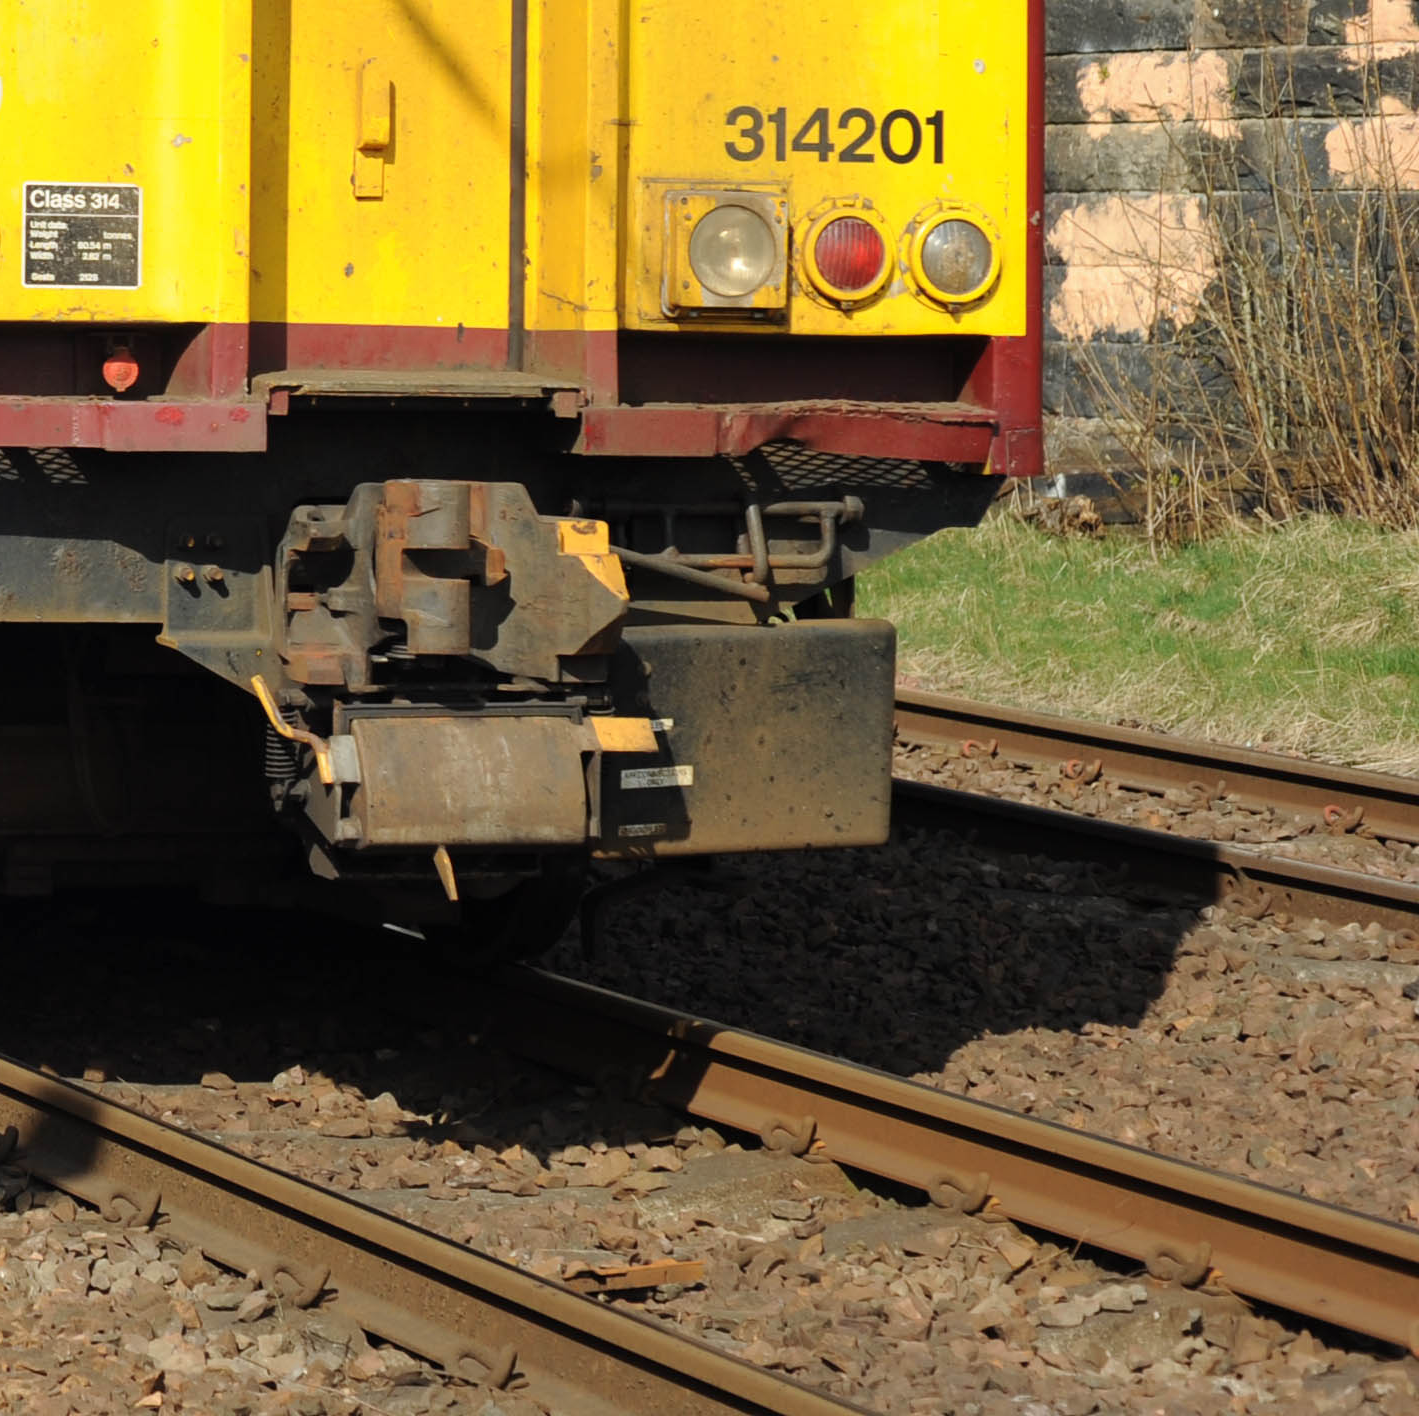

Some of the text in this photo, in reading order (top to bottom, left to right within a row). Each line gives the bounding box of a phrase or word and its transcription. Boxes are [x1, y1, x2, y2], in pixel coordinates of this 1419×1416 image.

[724, 106, 945, 165] 314201
[29, 189, 121, 210] Class 314
[29, 220, 47, 230] Unit
[29, 240, 58, 251] Length
